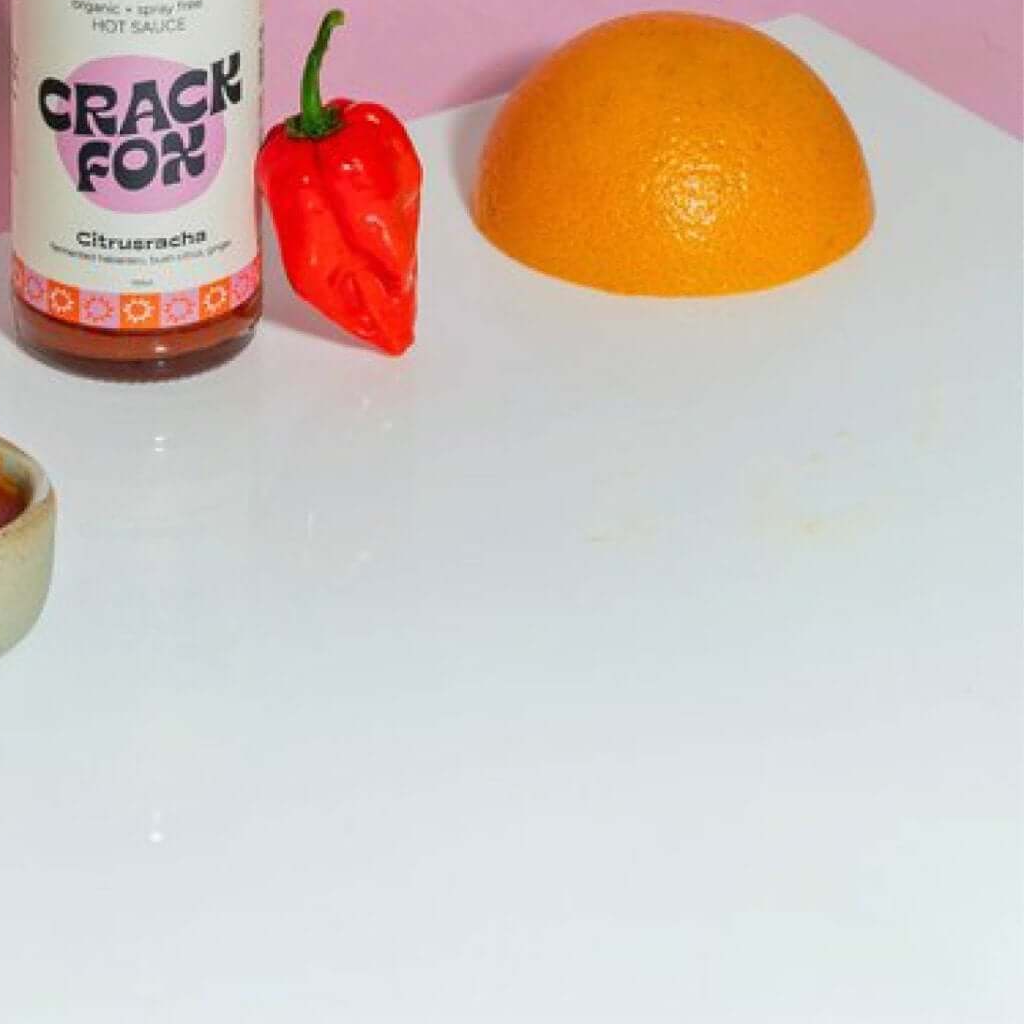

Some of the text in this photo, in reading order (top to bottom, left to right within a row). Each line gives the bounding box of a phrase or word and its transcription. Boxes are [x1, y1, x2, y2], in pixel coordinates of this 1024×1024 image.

[70, 0, 121, 14] organic
[137, 4, 174, 16] spray
[92, 17, 186, 34] HOT SAUCE
[38, 50, 241, 137] CRACK
[77, 123, 206, 193] FOX
[76, 230, 207, 251] Citrusracha
